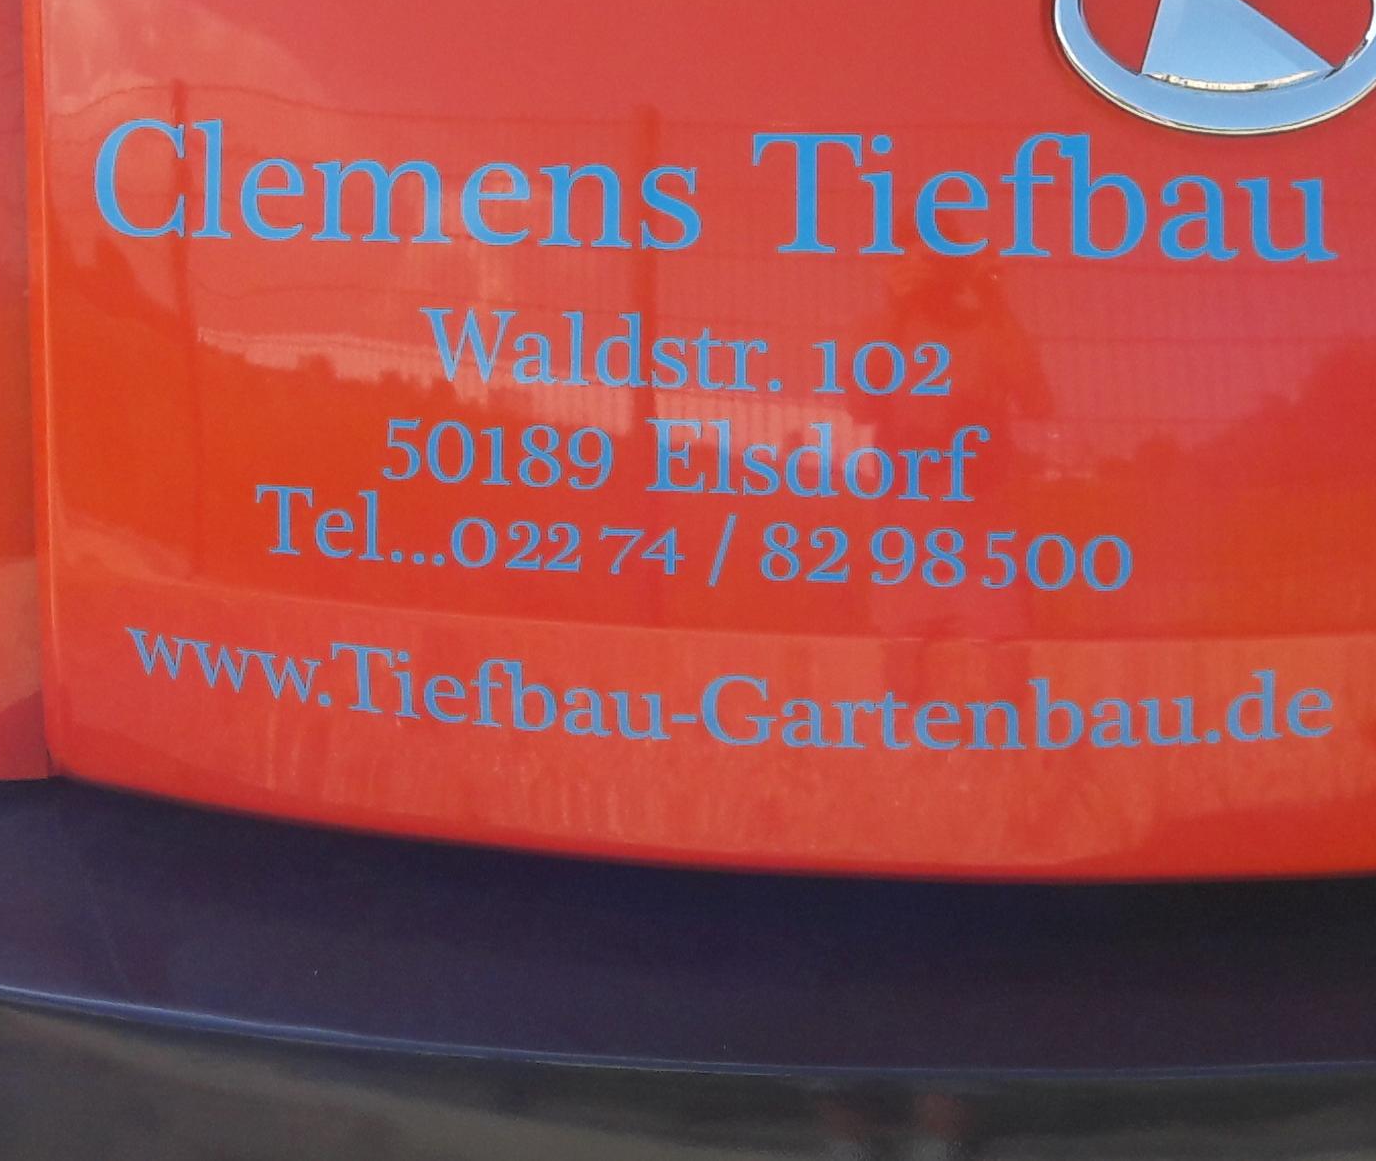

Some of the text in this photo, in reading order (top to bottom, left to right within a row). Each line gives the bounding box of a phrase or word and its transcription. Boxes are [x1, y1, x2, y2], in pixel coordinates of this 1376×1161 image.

[92, 118, 1338, 263] Clemens Tiefbau
[420, 306, 952, 397] Waldstr. 102
[381, 417, 991, 502] 50189 Elsdorf
[126, 625, 1334, 752] www.Tiefbau-Gartenbau.de
